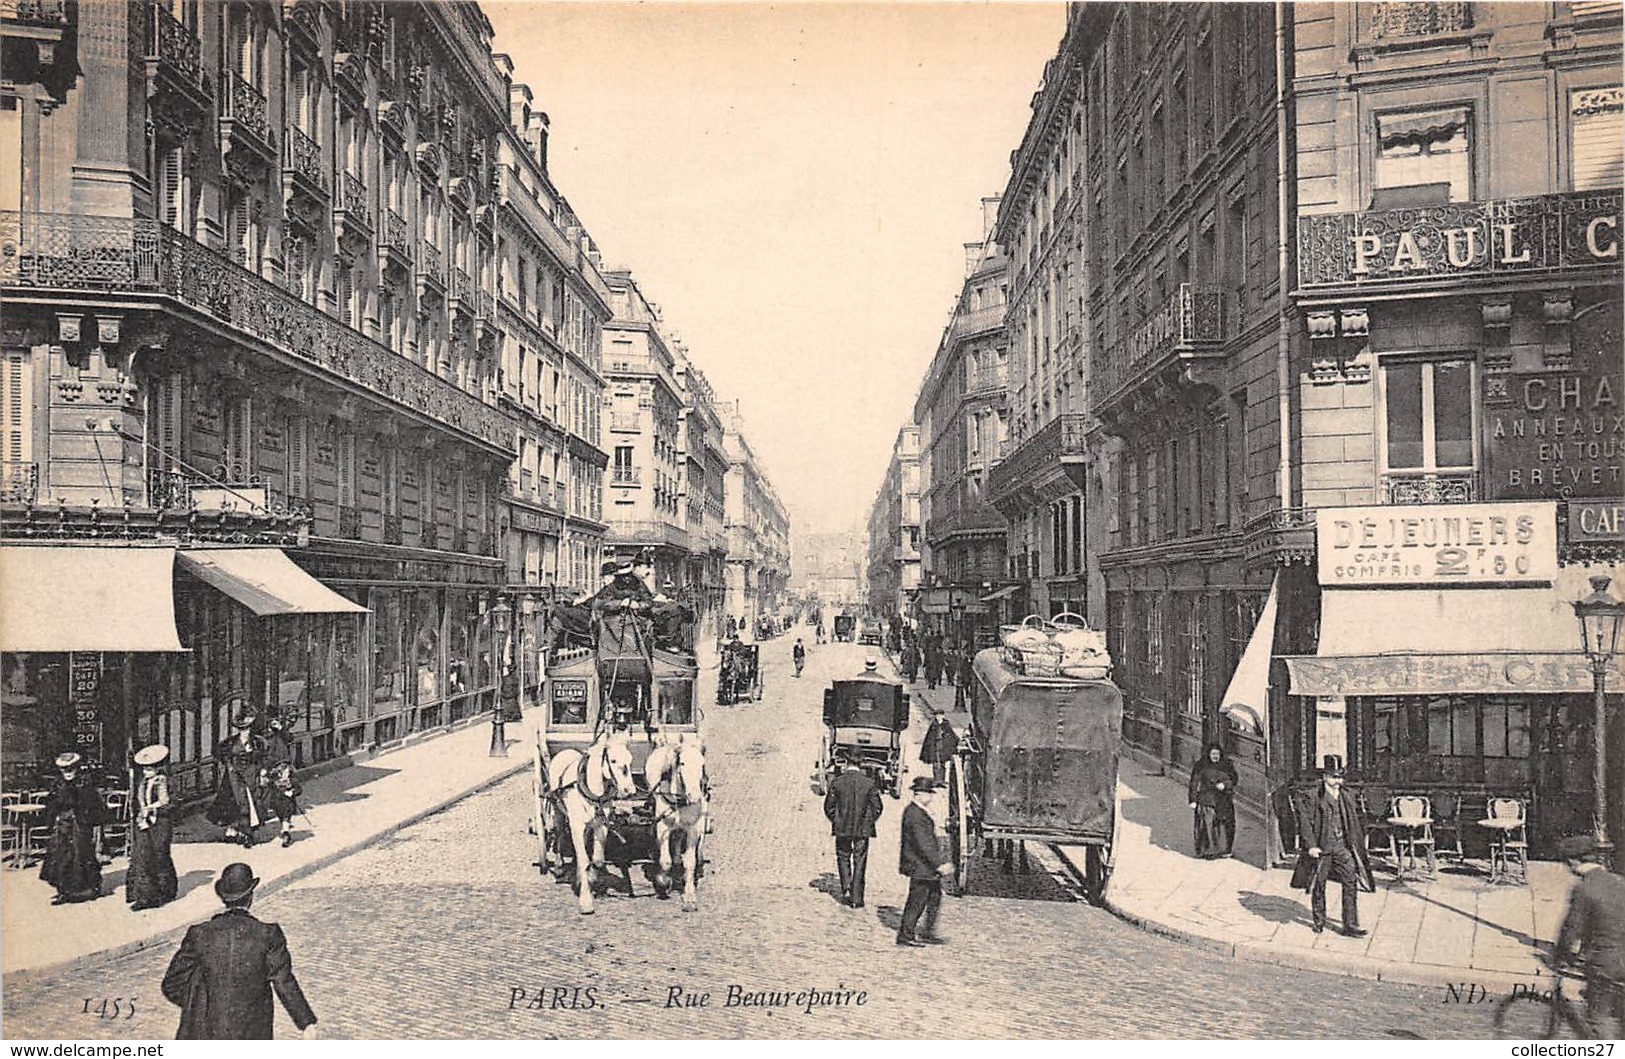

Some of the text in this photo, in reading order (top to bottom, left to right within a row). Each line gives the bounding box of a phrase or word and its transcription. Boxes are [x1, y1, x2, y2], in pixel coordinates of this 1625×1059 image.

[1352, 216, 1618, 274] PAUL C
[1524, 375, 1617, 412] CHA
[1494, 416, 1624, 438] ANNEAUX
[1540, 443, 1564, 460] EN
[1333, 514, 1533, 549] DÉJEUNERS
[1334, 564, 1423, 577] COMPRIS
